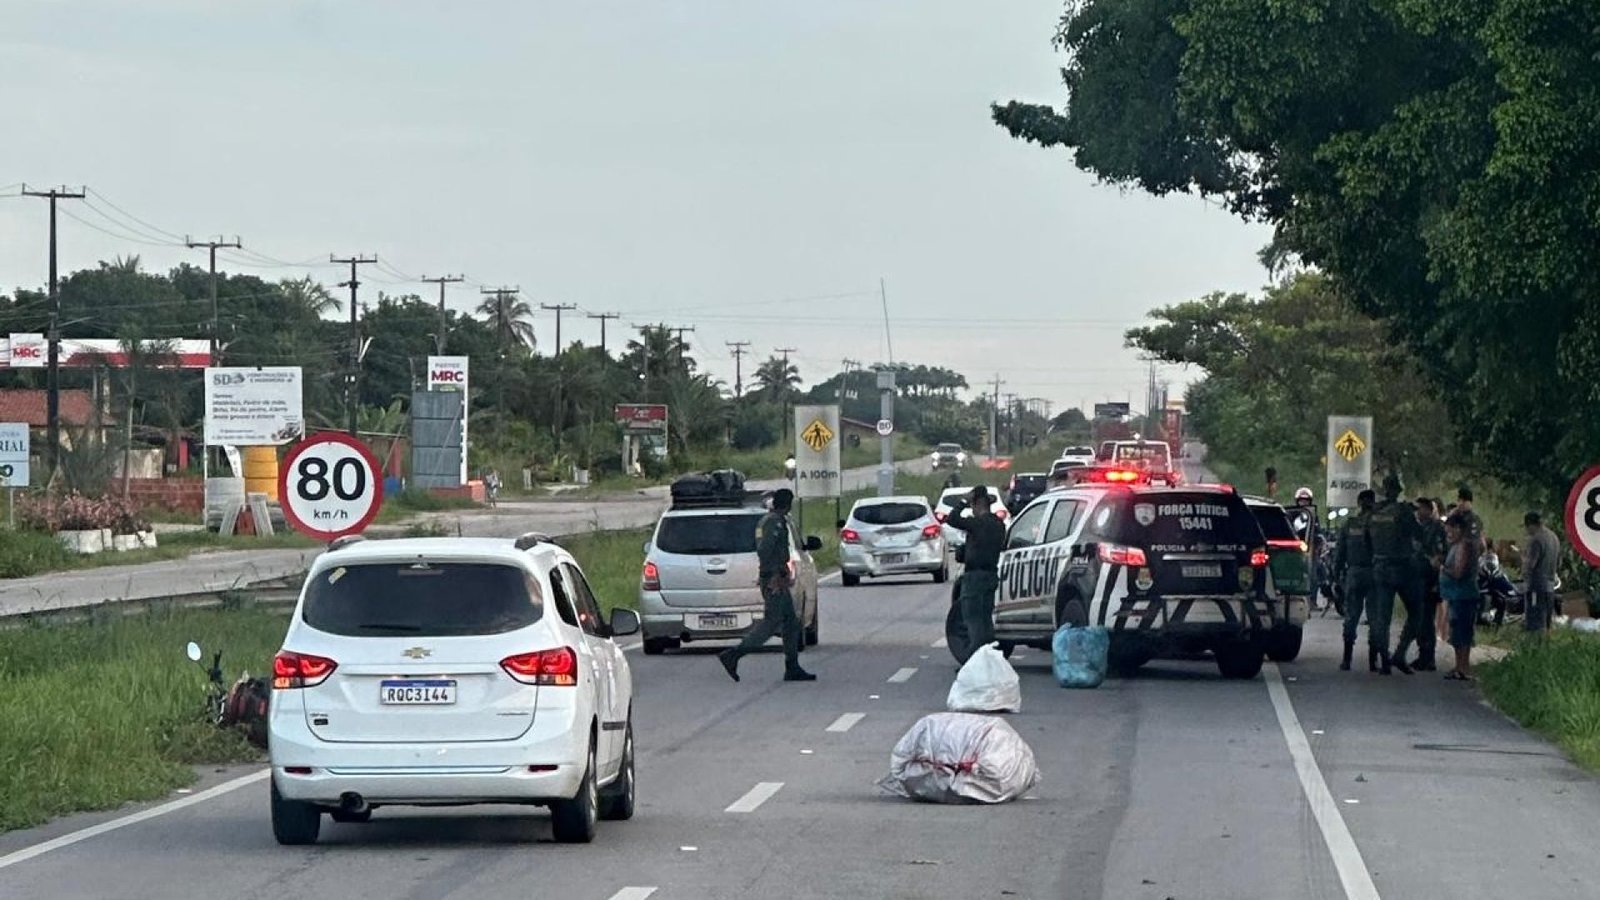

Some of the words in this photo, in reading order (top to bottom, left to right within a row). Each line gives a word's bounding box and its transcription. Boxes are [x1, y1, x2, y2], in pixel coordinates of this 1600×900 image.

[13, 348, 41, 358] MRC
[431, 370, 464, 382] MRC
[879, 421, 891, 431] 80
[297, 457, 366, 501] 80
[800, 471, 807, 480] A
[810, 470, 838, 480] 100m
[1330, 480, 1338, 488] A
[313, 509, 349, 519] km/h
[1158, 504, 1194, 516] FORÇA
[1180, 517, 1213, 530] 15441
[388, 688, 448, 702] RQC3I44
